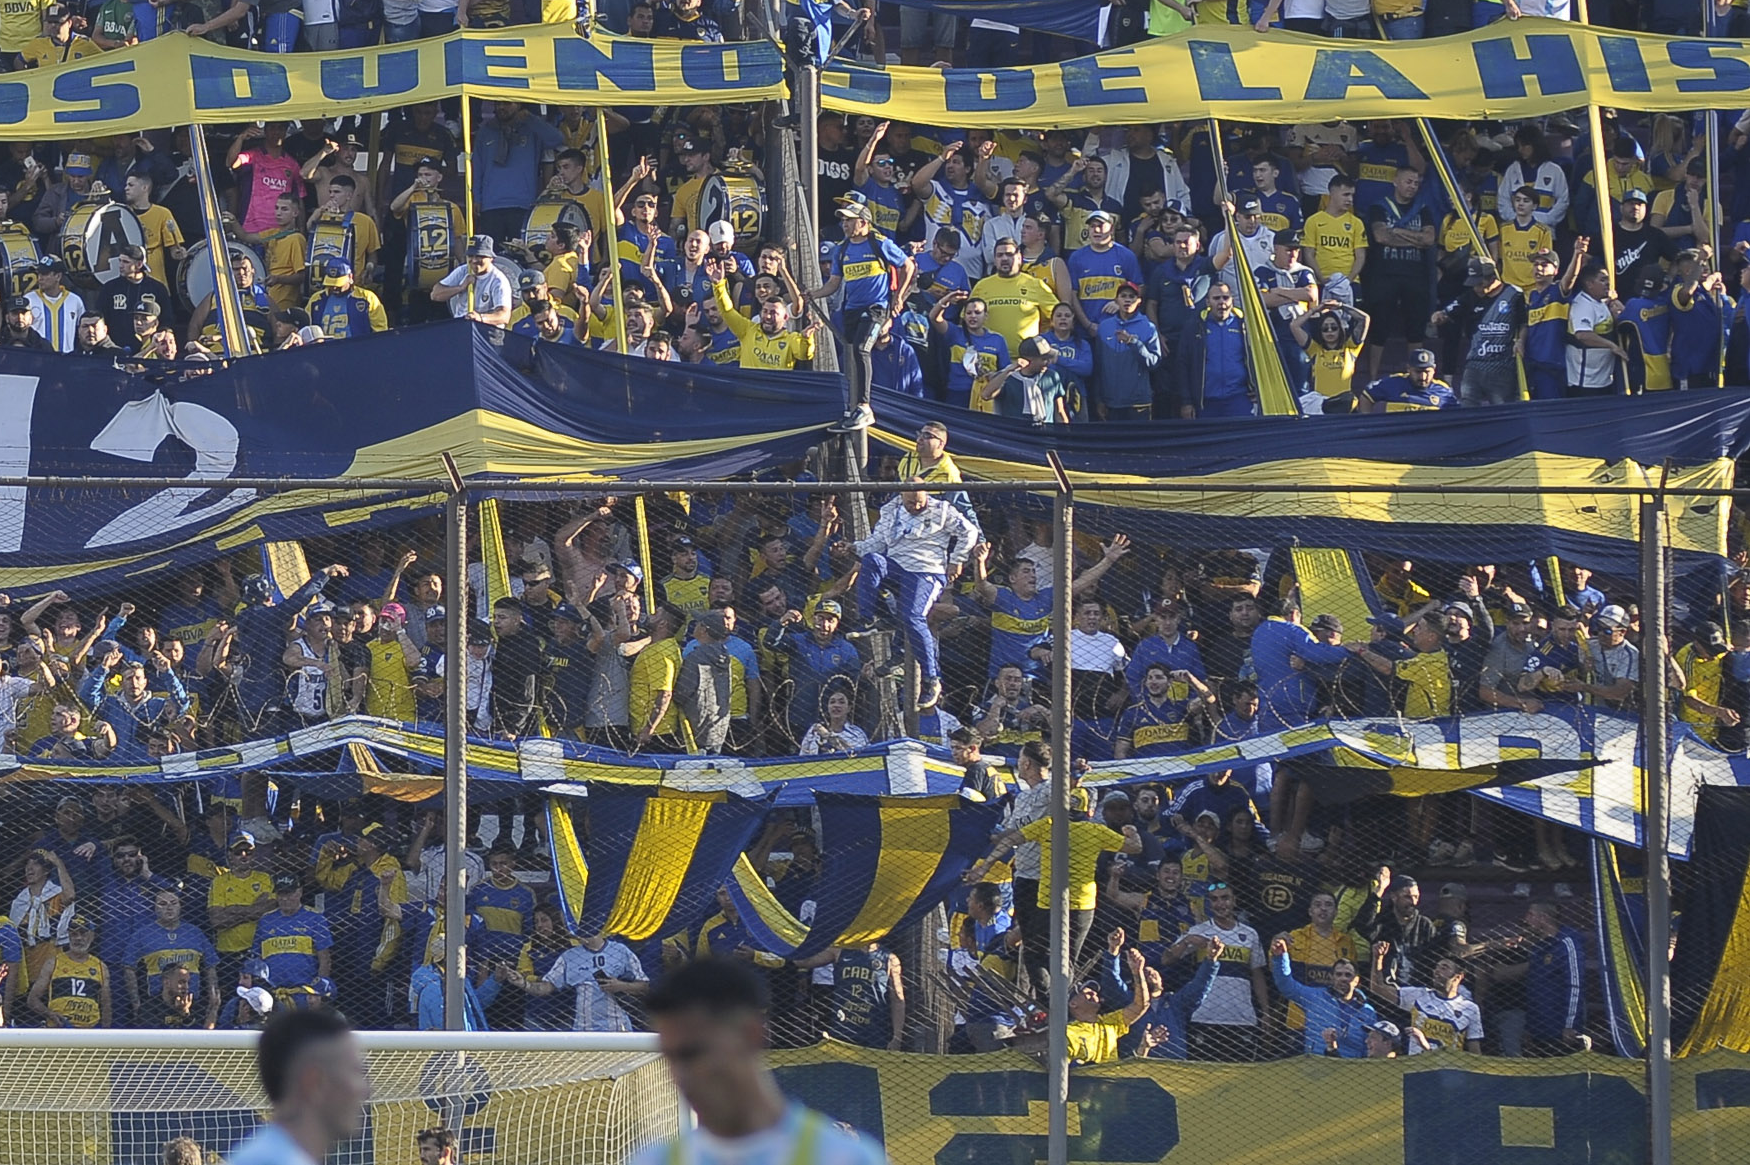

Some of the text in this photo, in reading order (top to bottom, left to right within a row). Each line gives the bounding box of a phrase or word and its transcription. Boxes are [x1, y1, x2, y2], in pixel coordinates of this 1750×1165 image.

[4, 1, 34, 12] BBVA
[104, 21, 127, 36] BBVA
[943, 47, 1149, 112] DE
[1187, 39, 1432, 101] LA
[1360, 167, 1388, 176] QATAR
[262, 177, 287, 187] QATAR
[731, 210, 757, 233] 12
[92, 209, 135, 285] A
[421, 230, 448, 252] 12
[1320, 235, 1350, 247] BBVA
[64, 249, 85, 270] 12
[1617, 248, 1641, 269] nike
[845, 264, 871, 275] QATAR
[11, 273, 37, 296] 12
[1084, 282, 1115, 293] Quilmes
[322, 315, 348, 339] 12
[710, 349, 737, 362] QATAR
[753, 348, 780, 362] QATAR
[676, 601, 704, 610] QATAR
[1268, 889, 1287, 903] 12
[270, 938, 296, 947] QATAR
[592, 955, 605, 967] 10
[1308, 970, 1332, 979] QATA
[71, 980, 85, 996] 12
[852, 985, 863, 996] 12
